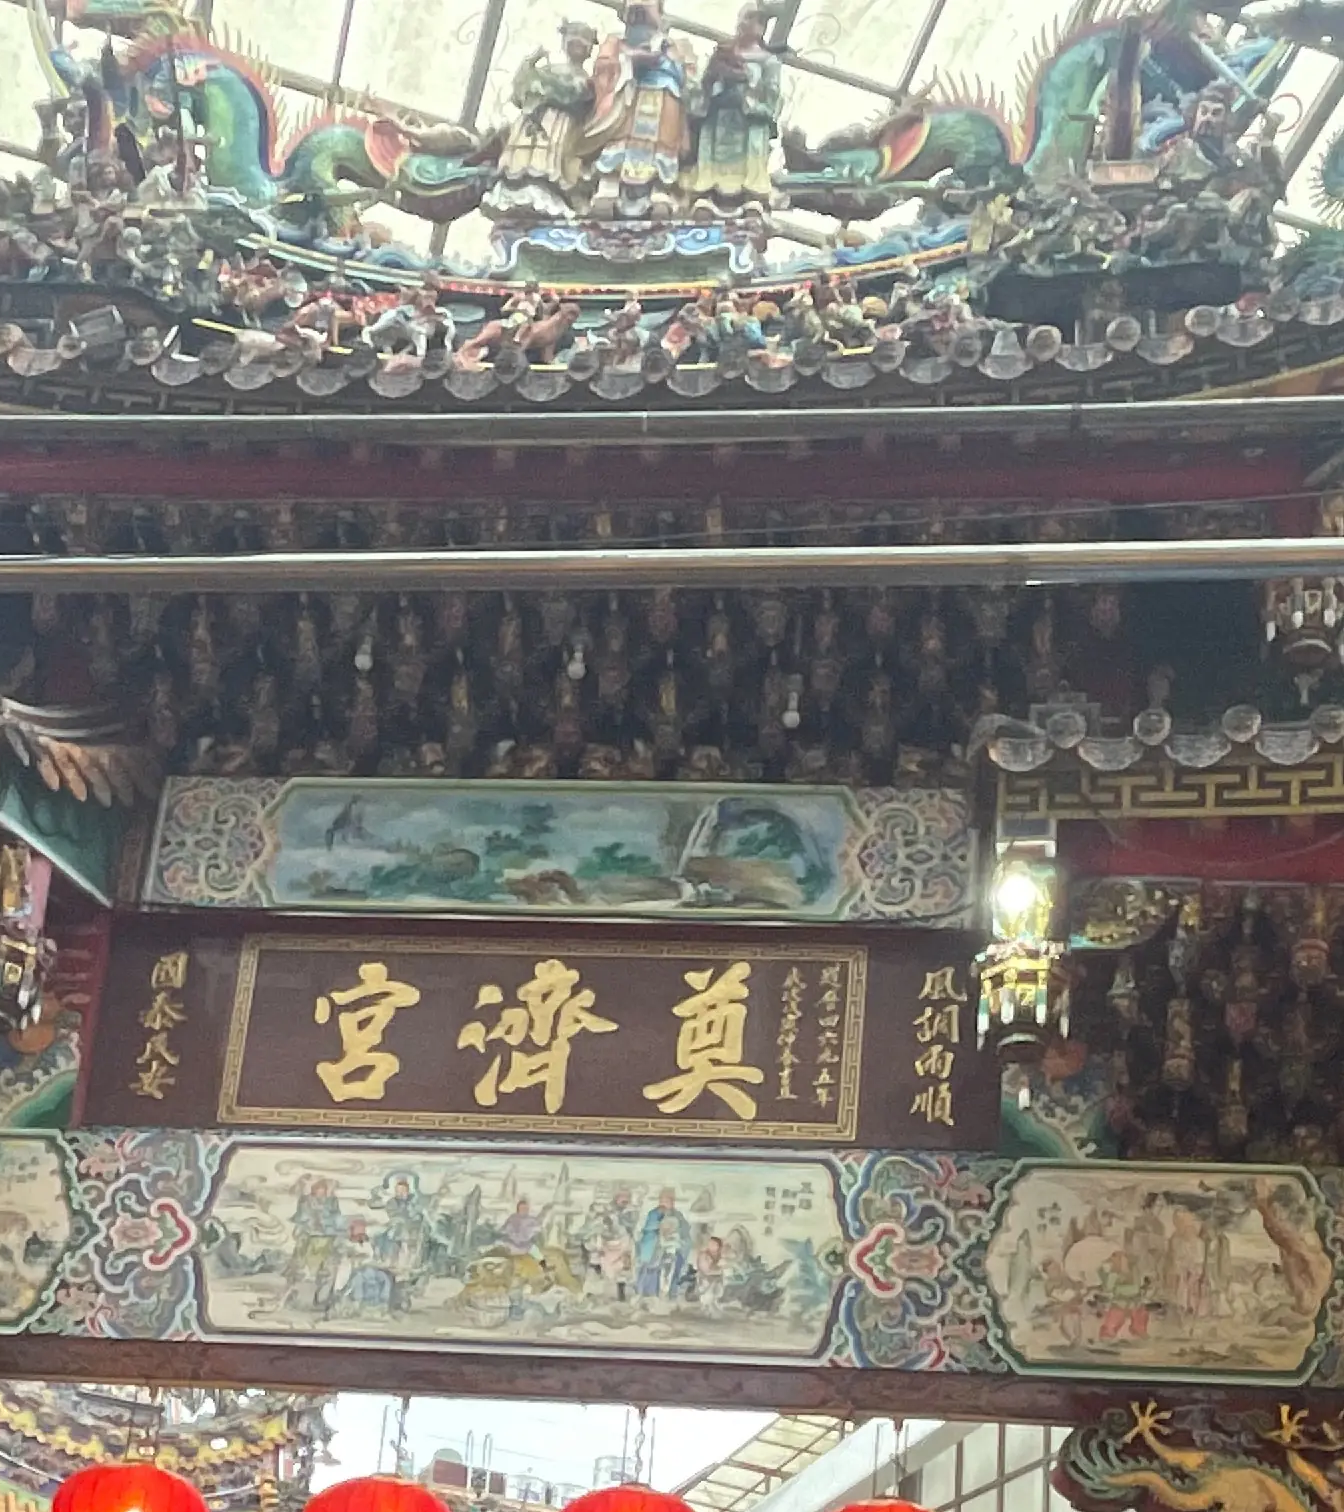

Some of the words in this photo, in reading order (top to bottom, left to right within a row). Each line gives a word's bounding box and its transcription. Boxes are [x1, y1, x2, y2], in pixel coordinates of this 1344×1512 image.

[129, 952, 190, 1101] 國泰民安
[314, 958, 765, 1122] 奠濟宮
[910, 966, 968, 1127] 風調雨順
